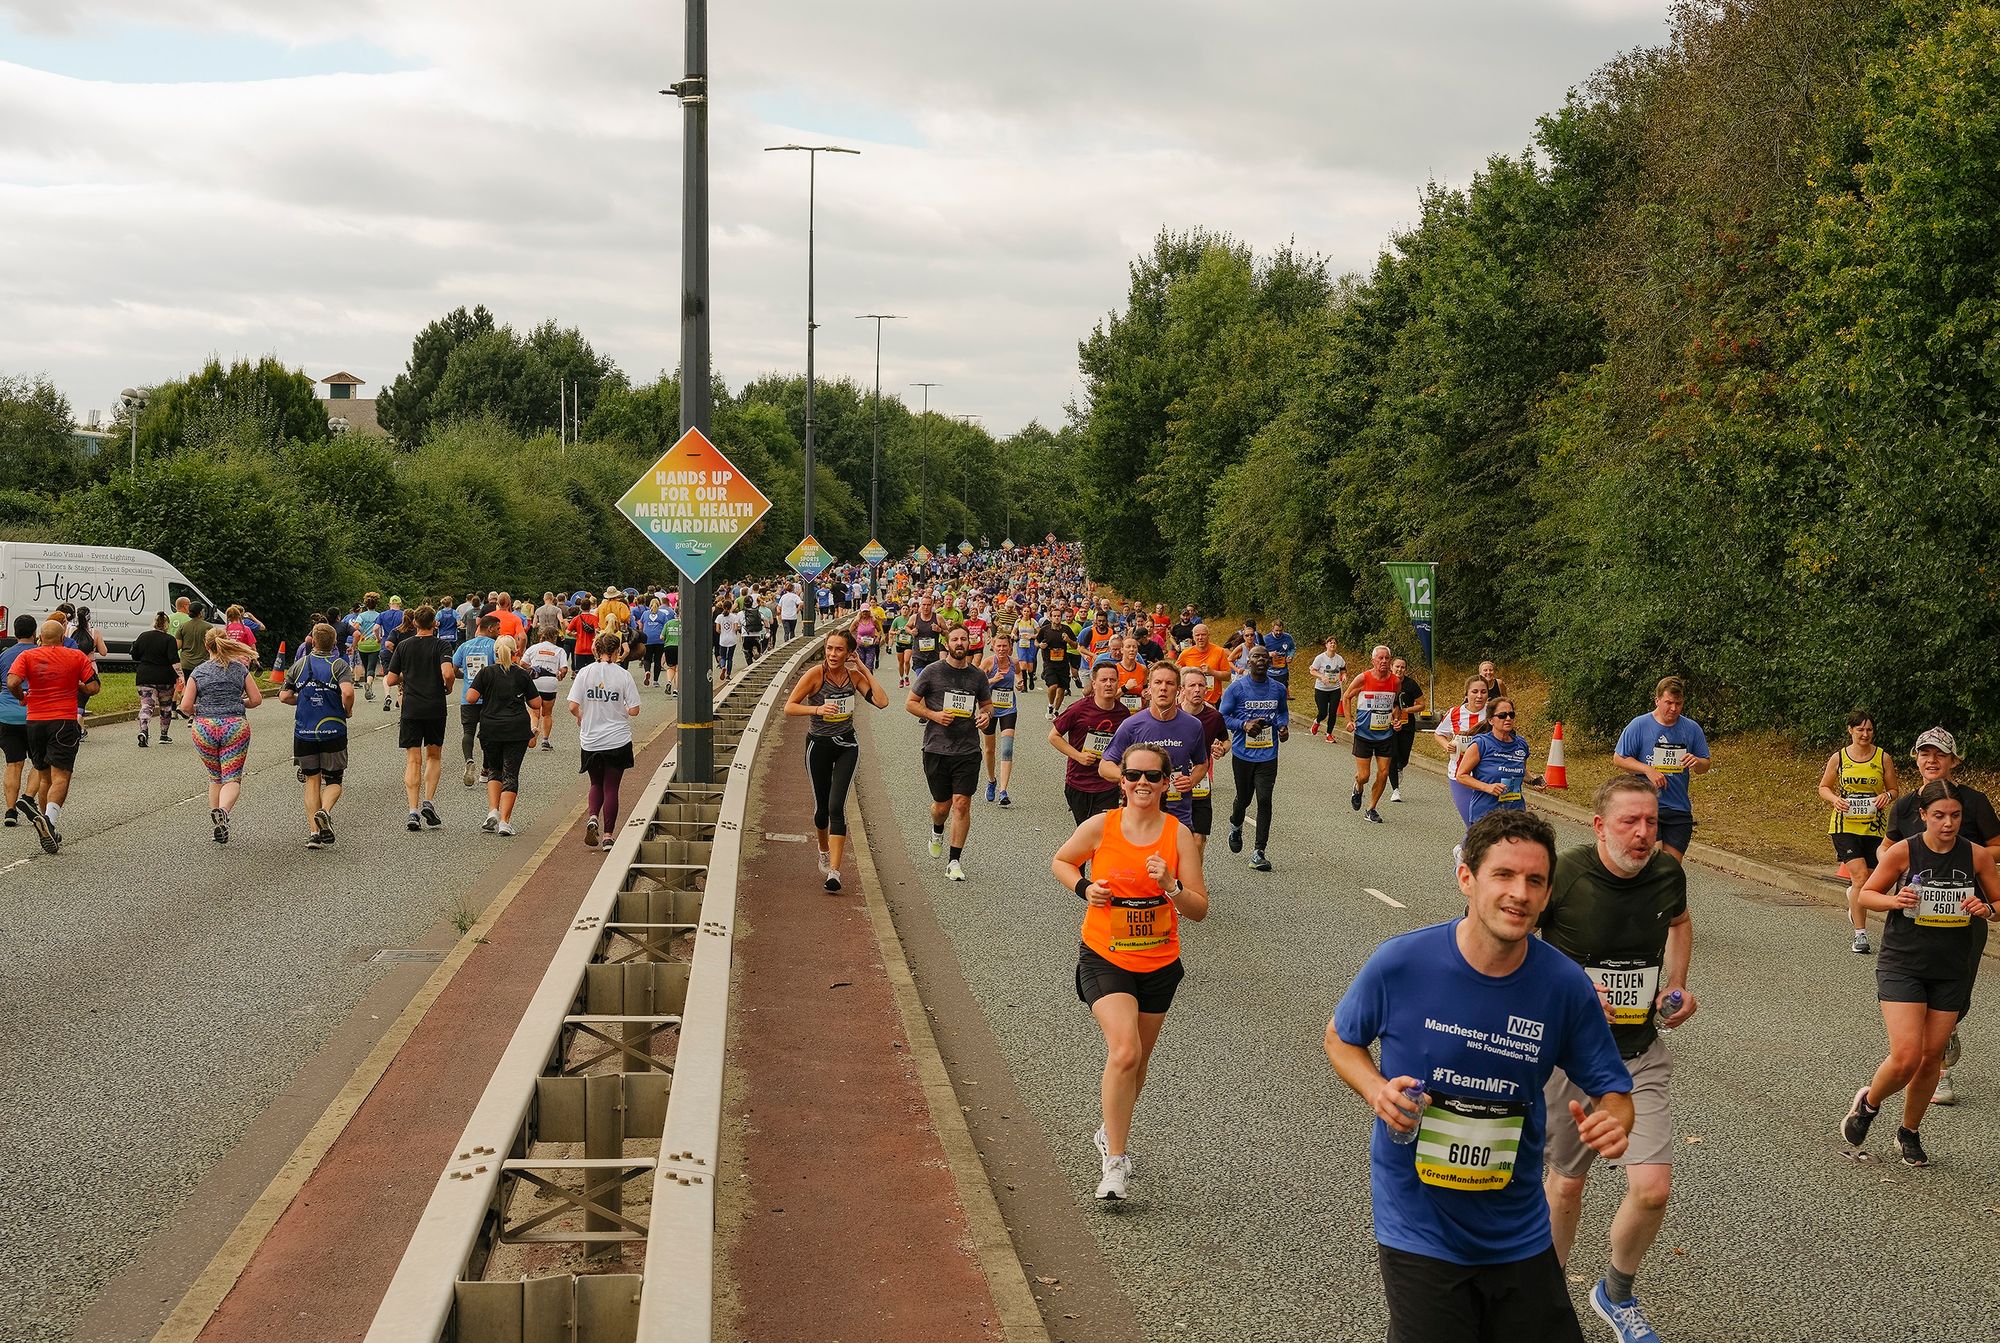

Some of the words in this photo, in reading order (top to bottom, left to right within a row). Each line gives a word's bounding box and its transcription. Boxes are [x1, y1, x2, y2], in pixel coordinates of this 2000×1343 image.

[656, 471, 706, 485] HANDS
[712, 471, 732, 485] UP
[660, 487, 689, 501] FOR
[695, 487, 727, 501] OUR
[635, 503, 694, 517] MENTAL
[700, 503, 753, 517] HEALTH
[650, 519, 738, 533] GUARDIANS
[675, 541, 692, 550] great
[697, 541, 712, 549] run
[43, 550, 62, 558] Audio
[63, 551, 84, 559] Visual
[91, 552, 109, 560] Event
[109, 553, 136, 562] Lighting
[24, 561, 45, 569] Dance
[74, 565, 95, 573] Stages
[120, 567, 153, 575] Specialists
[33, 571, 146, 616] Hipswing
[1405, 577, 1431, 605] 12
[586, 686, 620, 702] aliya
[952, 695, 967, 703] DAVID
[1843, 777, 1867, 785] HIVE
[1852, 807, 1868, 815] 3783
[1923, 890, 1967, 902] GEORGINA
[1932, 903, 1956, 914] 4501
[1126, 911, 1156, 923] HELEN
[1128, 924, 1154, 936] 1501
[1601, 972, 1644, 989] STEVEN
[1606, 991, 1638, 1006] 5025
[1509, 1018, 1542, 1038] NHS
[1425, 1017, 1489, 1041] Manchester
[1491, 1033, 1541, 1056] University
[1467, 1040, 1483, 1050] NHS
[1483, 1043, 1524, 1060] Foundation
[1524, 1054, 1539, 1063] Trust
[1432, 1066, 1519, 1095] #TeamMFT
[1449, 1143, 1491, 1167] 6060
[1498, 1161, 1512, 1170] 10K
[1421, 1169, 1504, 1185] #GreatManchesterRun
